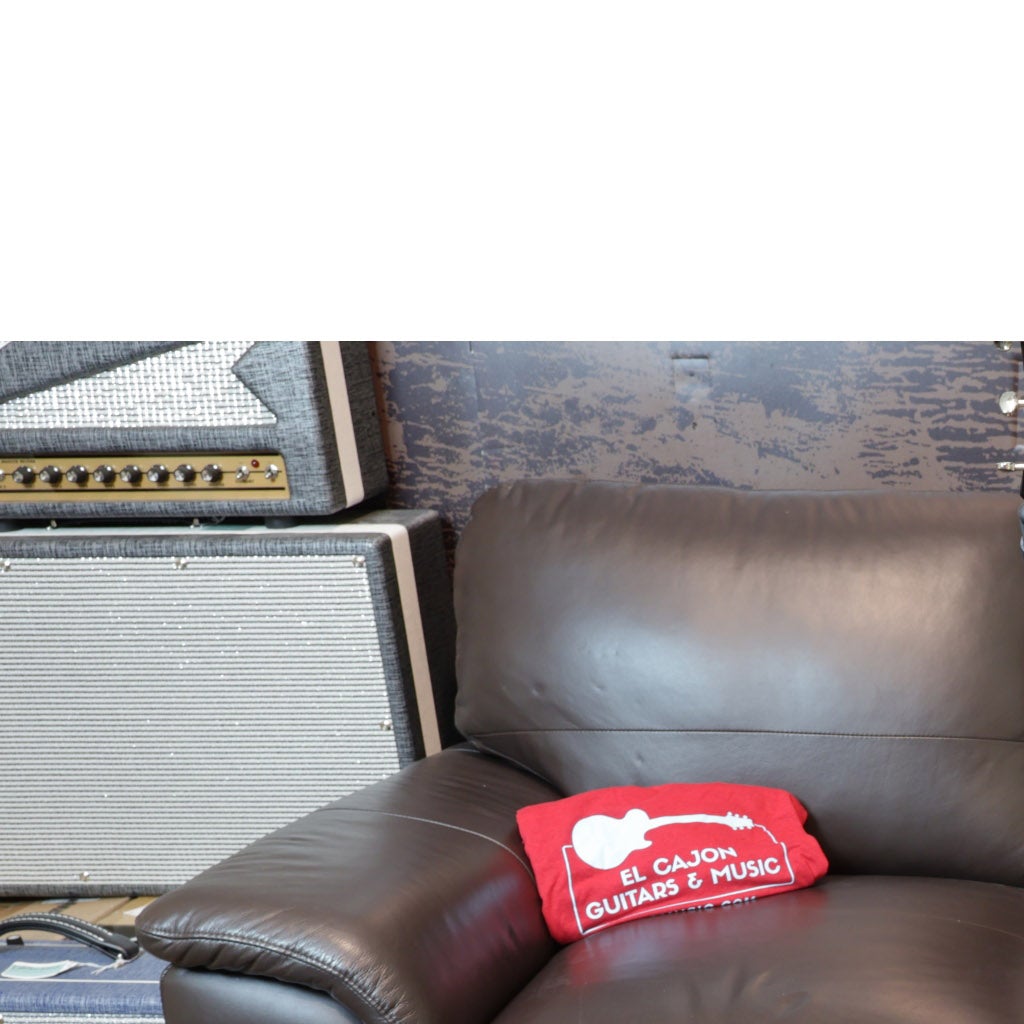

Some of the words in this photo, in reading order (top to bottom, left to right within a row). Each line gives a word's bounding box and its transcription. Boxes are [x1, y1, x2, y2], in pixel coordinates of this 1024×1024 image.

[584, 878, 680, 921] GUITARS
[687, 872, 704, 890] &
[710, 857, 781, 885] MUSIC
[619, 865, 647, 887] EL
[652, 847, 738, 876] CAJON
